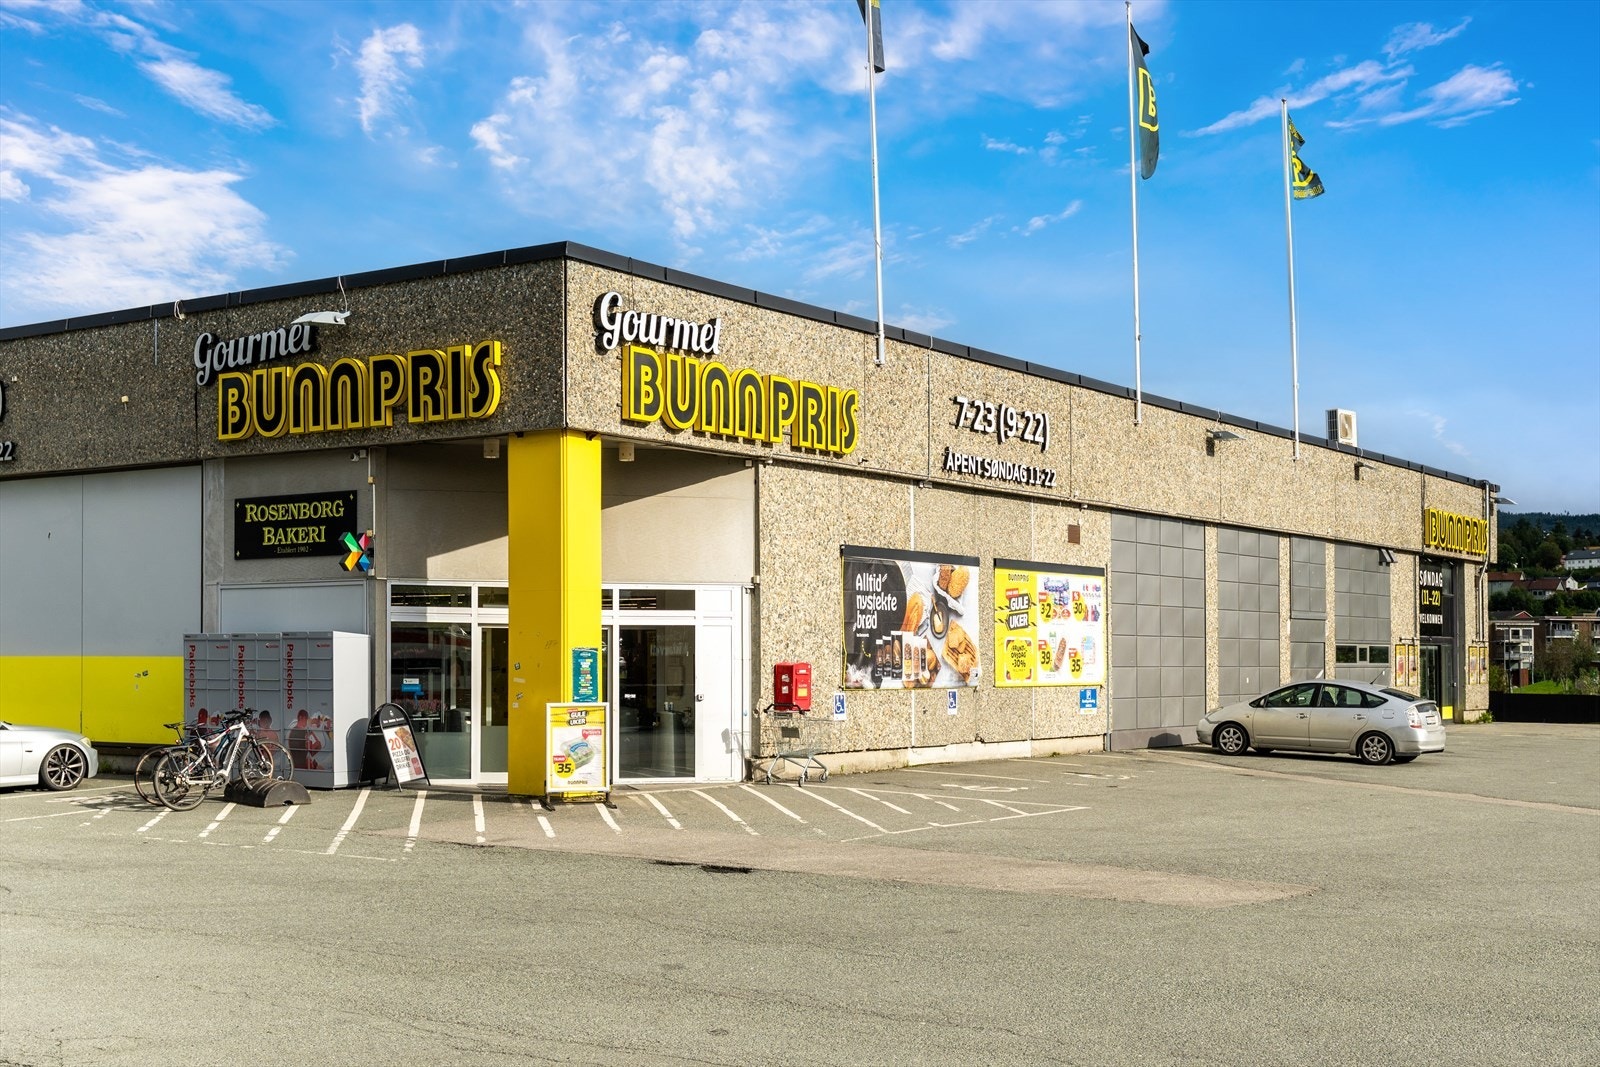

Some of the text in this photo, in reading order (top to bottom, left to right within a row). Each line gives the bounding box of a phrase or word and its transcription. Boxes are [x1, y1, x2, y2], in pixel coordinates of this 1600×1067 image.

[600, 291, 722, 355] Gourmet
[218, 340, 501, 441] BUNNPRIS
[622, 345, 859, 455] BUNNPRIS
[954, 395, 1050, 452] 7-23 (9-22)
[944, 446, 1057, 487] ÅPENT SØNDAG 11-22
[245, 500, 345, 523] ROSENBORG
[262, 526, 326, 546] BAKERI
[1424, 508, 1488, 556] BUNNPRIS
[855, 572, 882, 592] Alltid
[1419, 570, 1443, 588] SØNDAG
[856, 591, 898, 612] nystekte
[1010, 595, 1029, 611] GULE
[856, 610, 878, 629] brød
[1009, 613, 1029, 629] UKER
[569, 718, 586, 726] UKER
[570, 711, 587, 719] GULE
